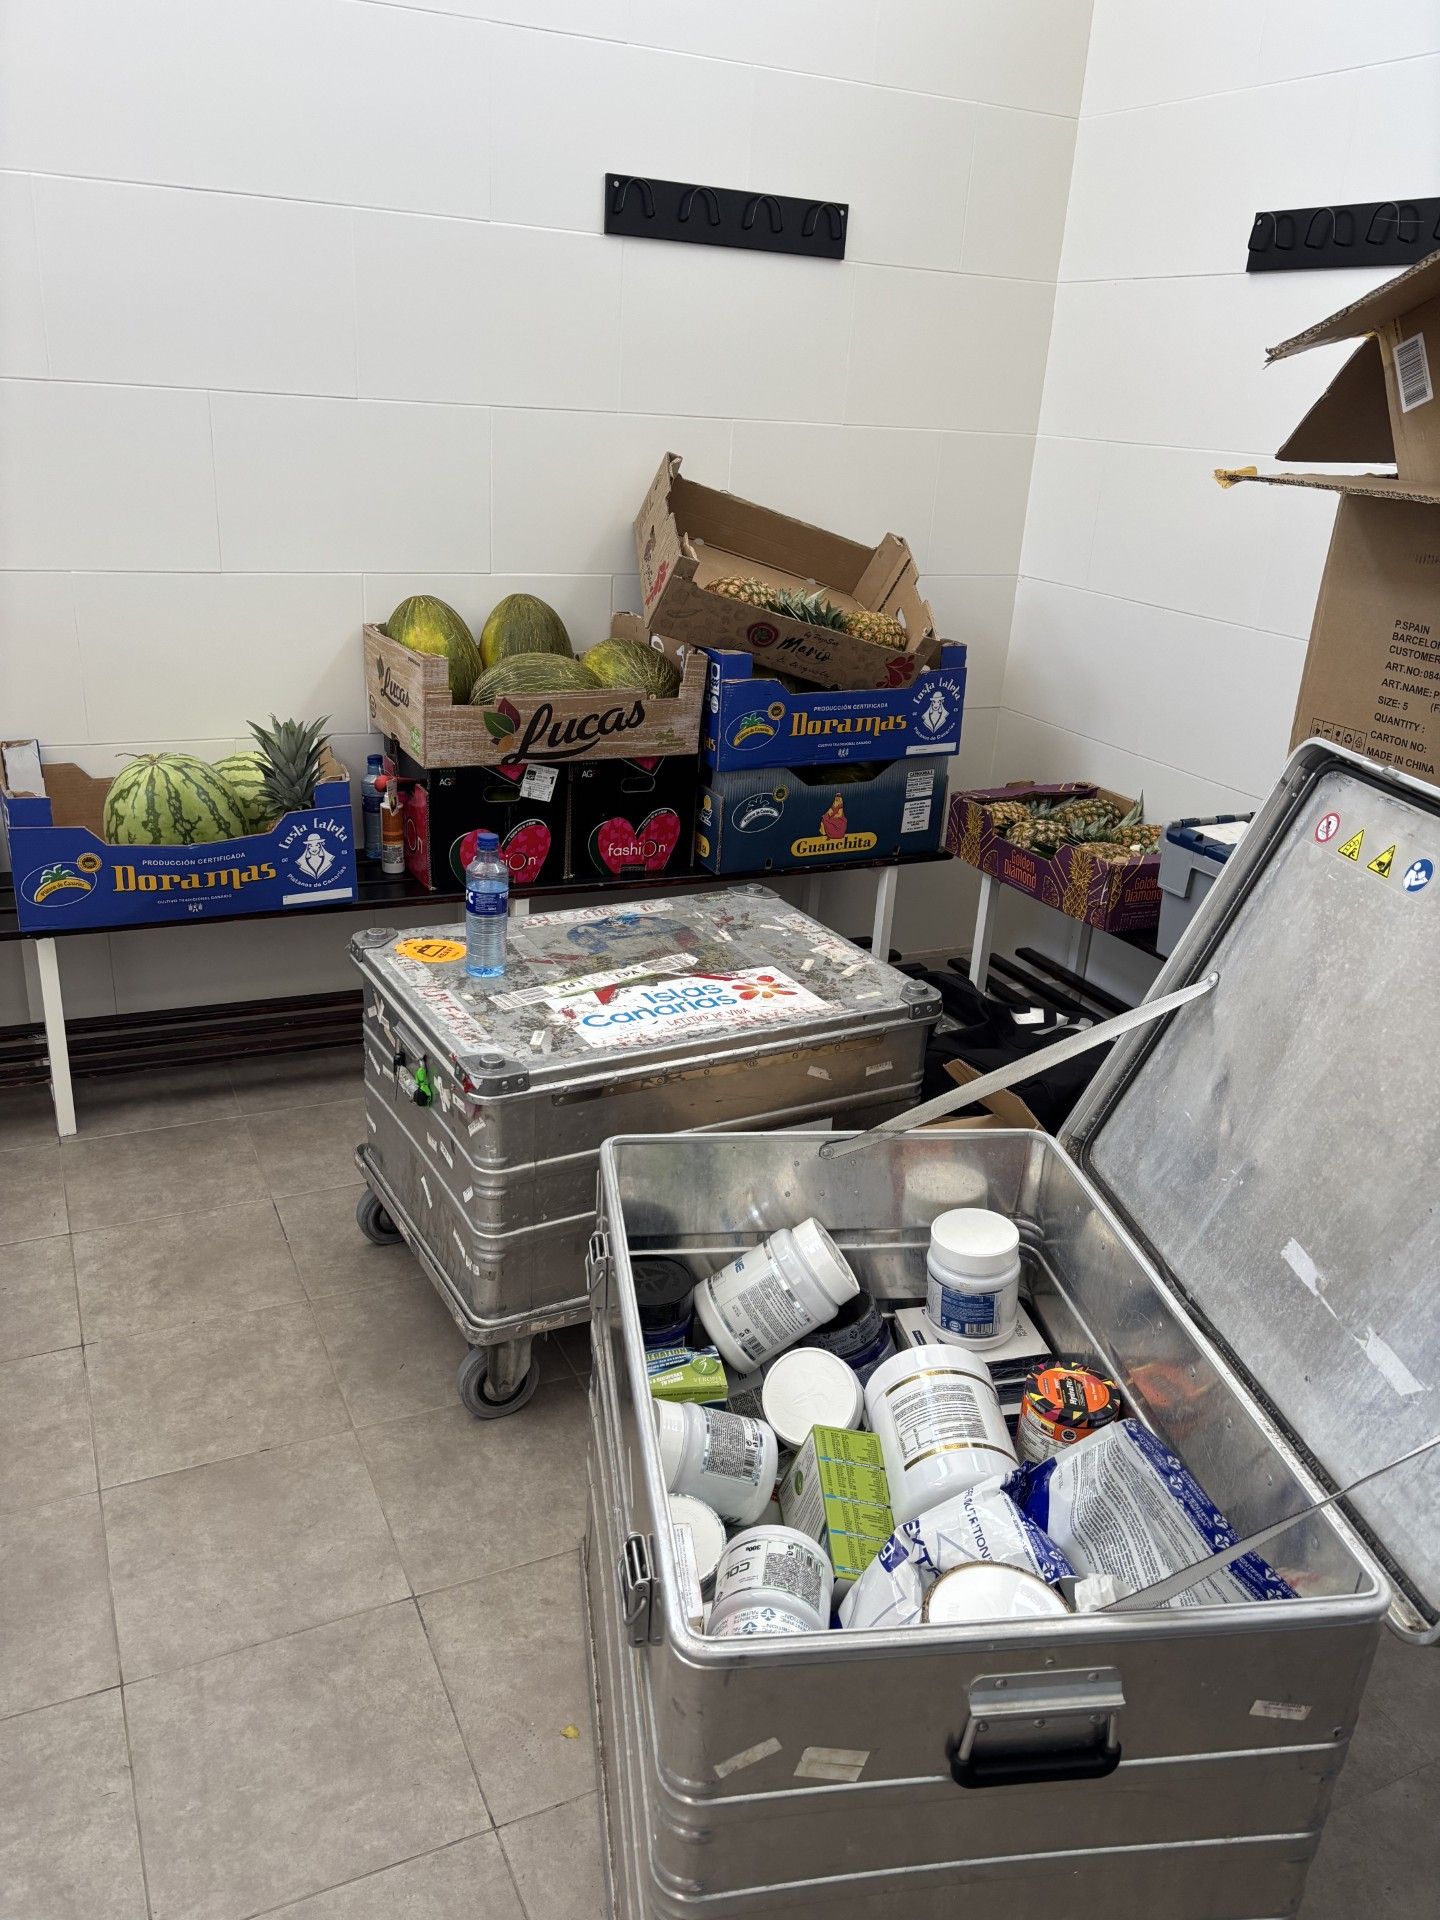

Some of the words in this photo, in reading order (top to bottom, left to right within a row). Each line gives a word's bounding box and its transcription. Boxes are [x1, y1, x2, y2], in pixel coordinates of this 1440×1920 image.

[1395, 619, 1431, 635] P.SPAIN
[380, 667, 410, 708] Lucas
[1377, 695, 1400, 709] SIZE:
[501, 699, 646, 765] Lucas
[788, 712, 907, 737] Doramas
[1370, 730, 1408, 748] CARTON
[1409, 741, 1427, 754] NO:
[1366, 746, 1392, 762] MADE
[1393, 755, 1404, 766] IN
[1405, 758, 1435, 774] CHINA
[197, 852, 246, 865] CERTIFICADA
[796, 836, 873, 856] Guanchita
[1004, 858, 1037, 889] Diamond
[1011, 849, 1035, 874] Golden
[111, 862, 277, 892] Doramas
[641, 984, 723, 1005] Islas
[582, 994, 738, 1028] Canarias
